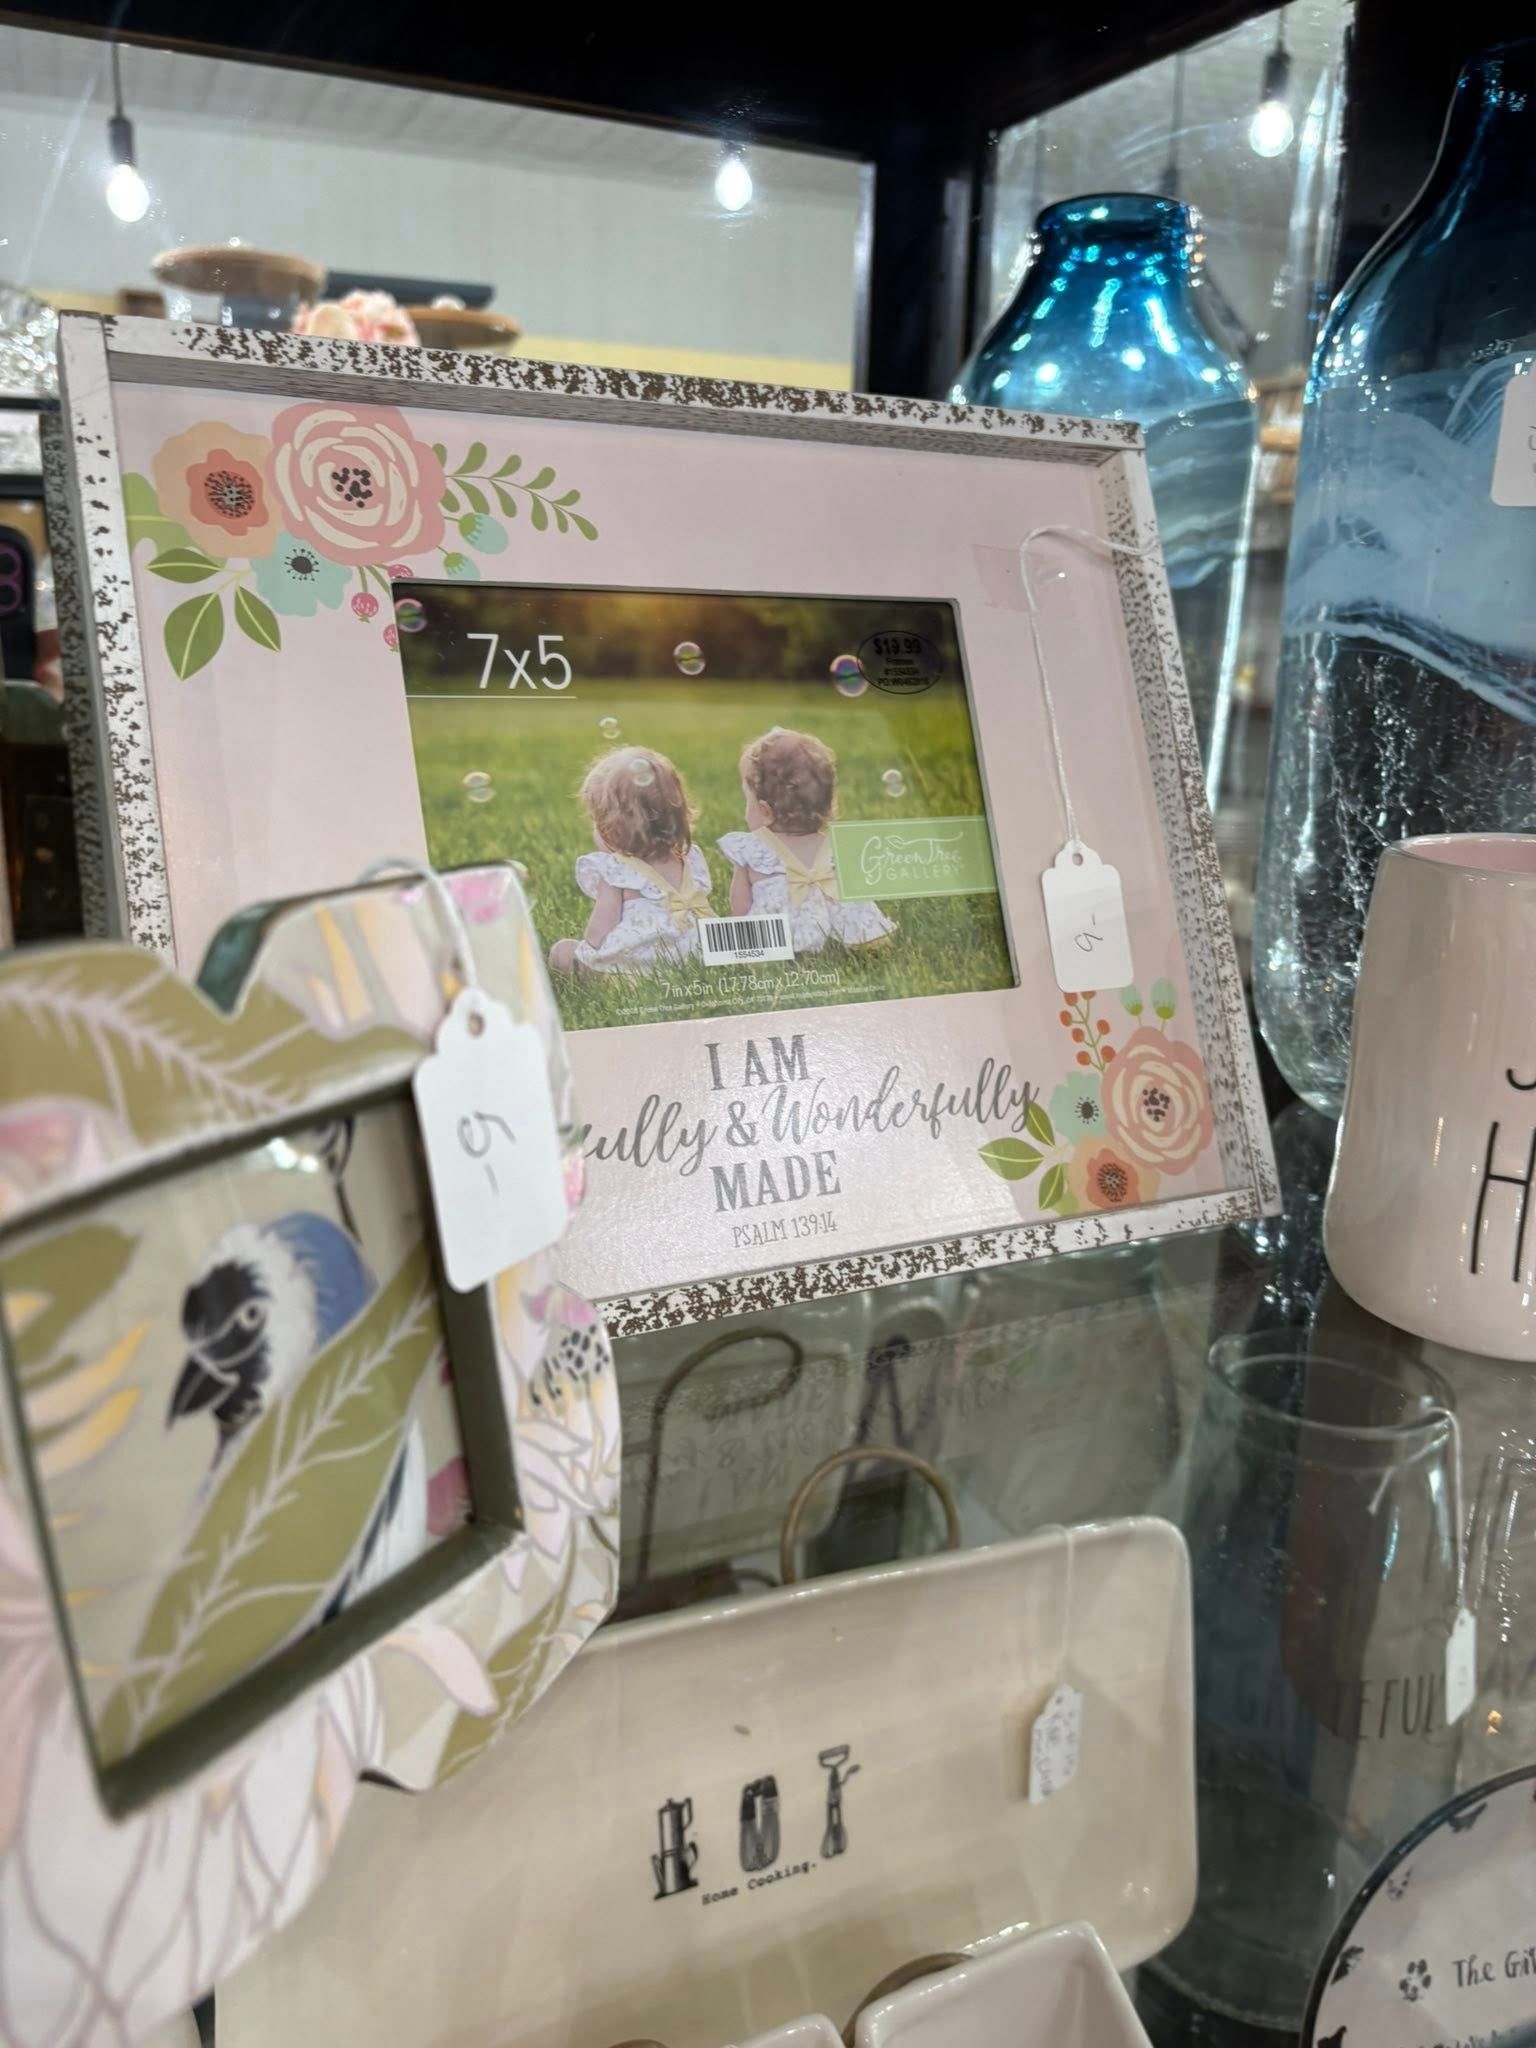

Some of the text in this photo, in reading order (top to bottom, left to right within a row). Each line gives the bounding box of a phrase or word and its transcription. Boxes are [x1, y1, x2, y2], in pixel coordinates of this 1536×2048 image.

[466, 632, 573, 691] 7x5
[886, 864, 964, 881] GALLERY
[704, 1034, 810, 1091] I AM
[725, 1100, 760, 1147] &
[762, 1057, 1041, 1145] Wonderfully
[709, 1150, 842, 1213] MADE
[732, 1210, 838, 1248] PSALM 139:14
[702, 1860, 818, 1906] Home Cooking.
[1451, 1953, 1496, 1988] The
